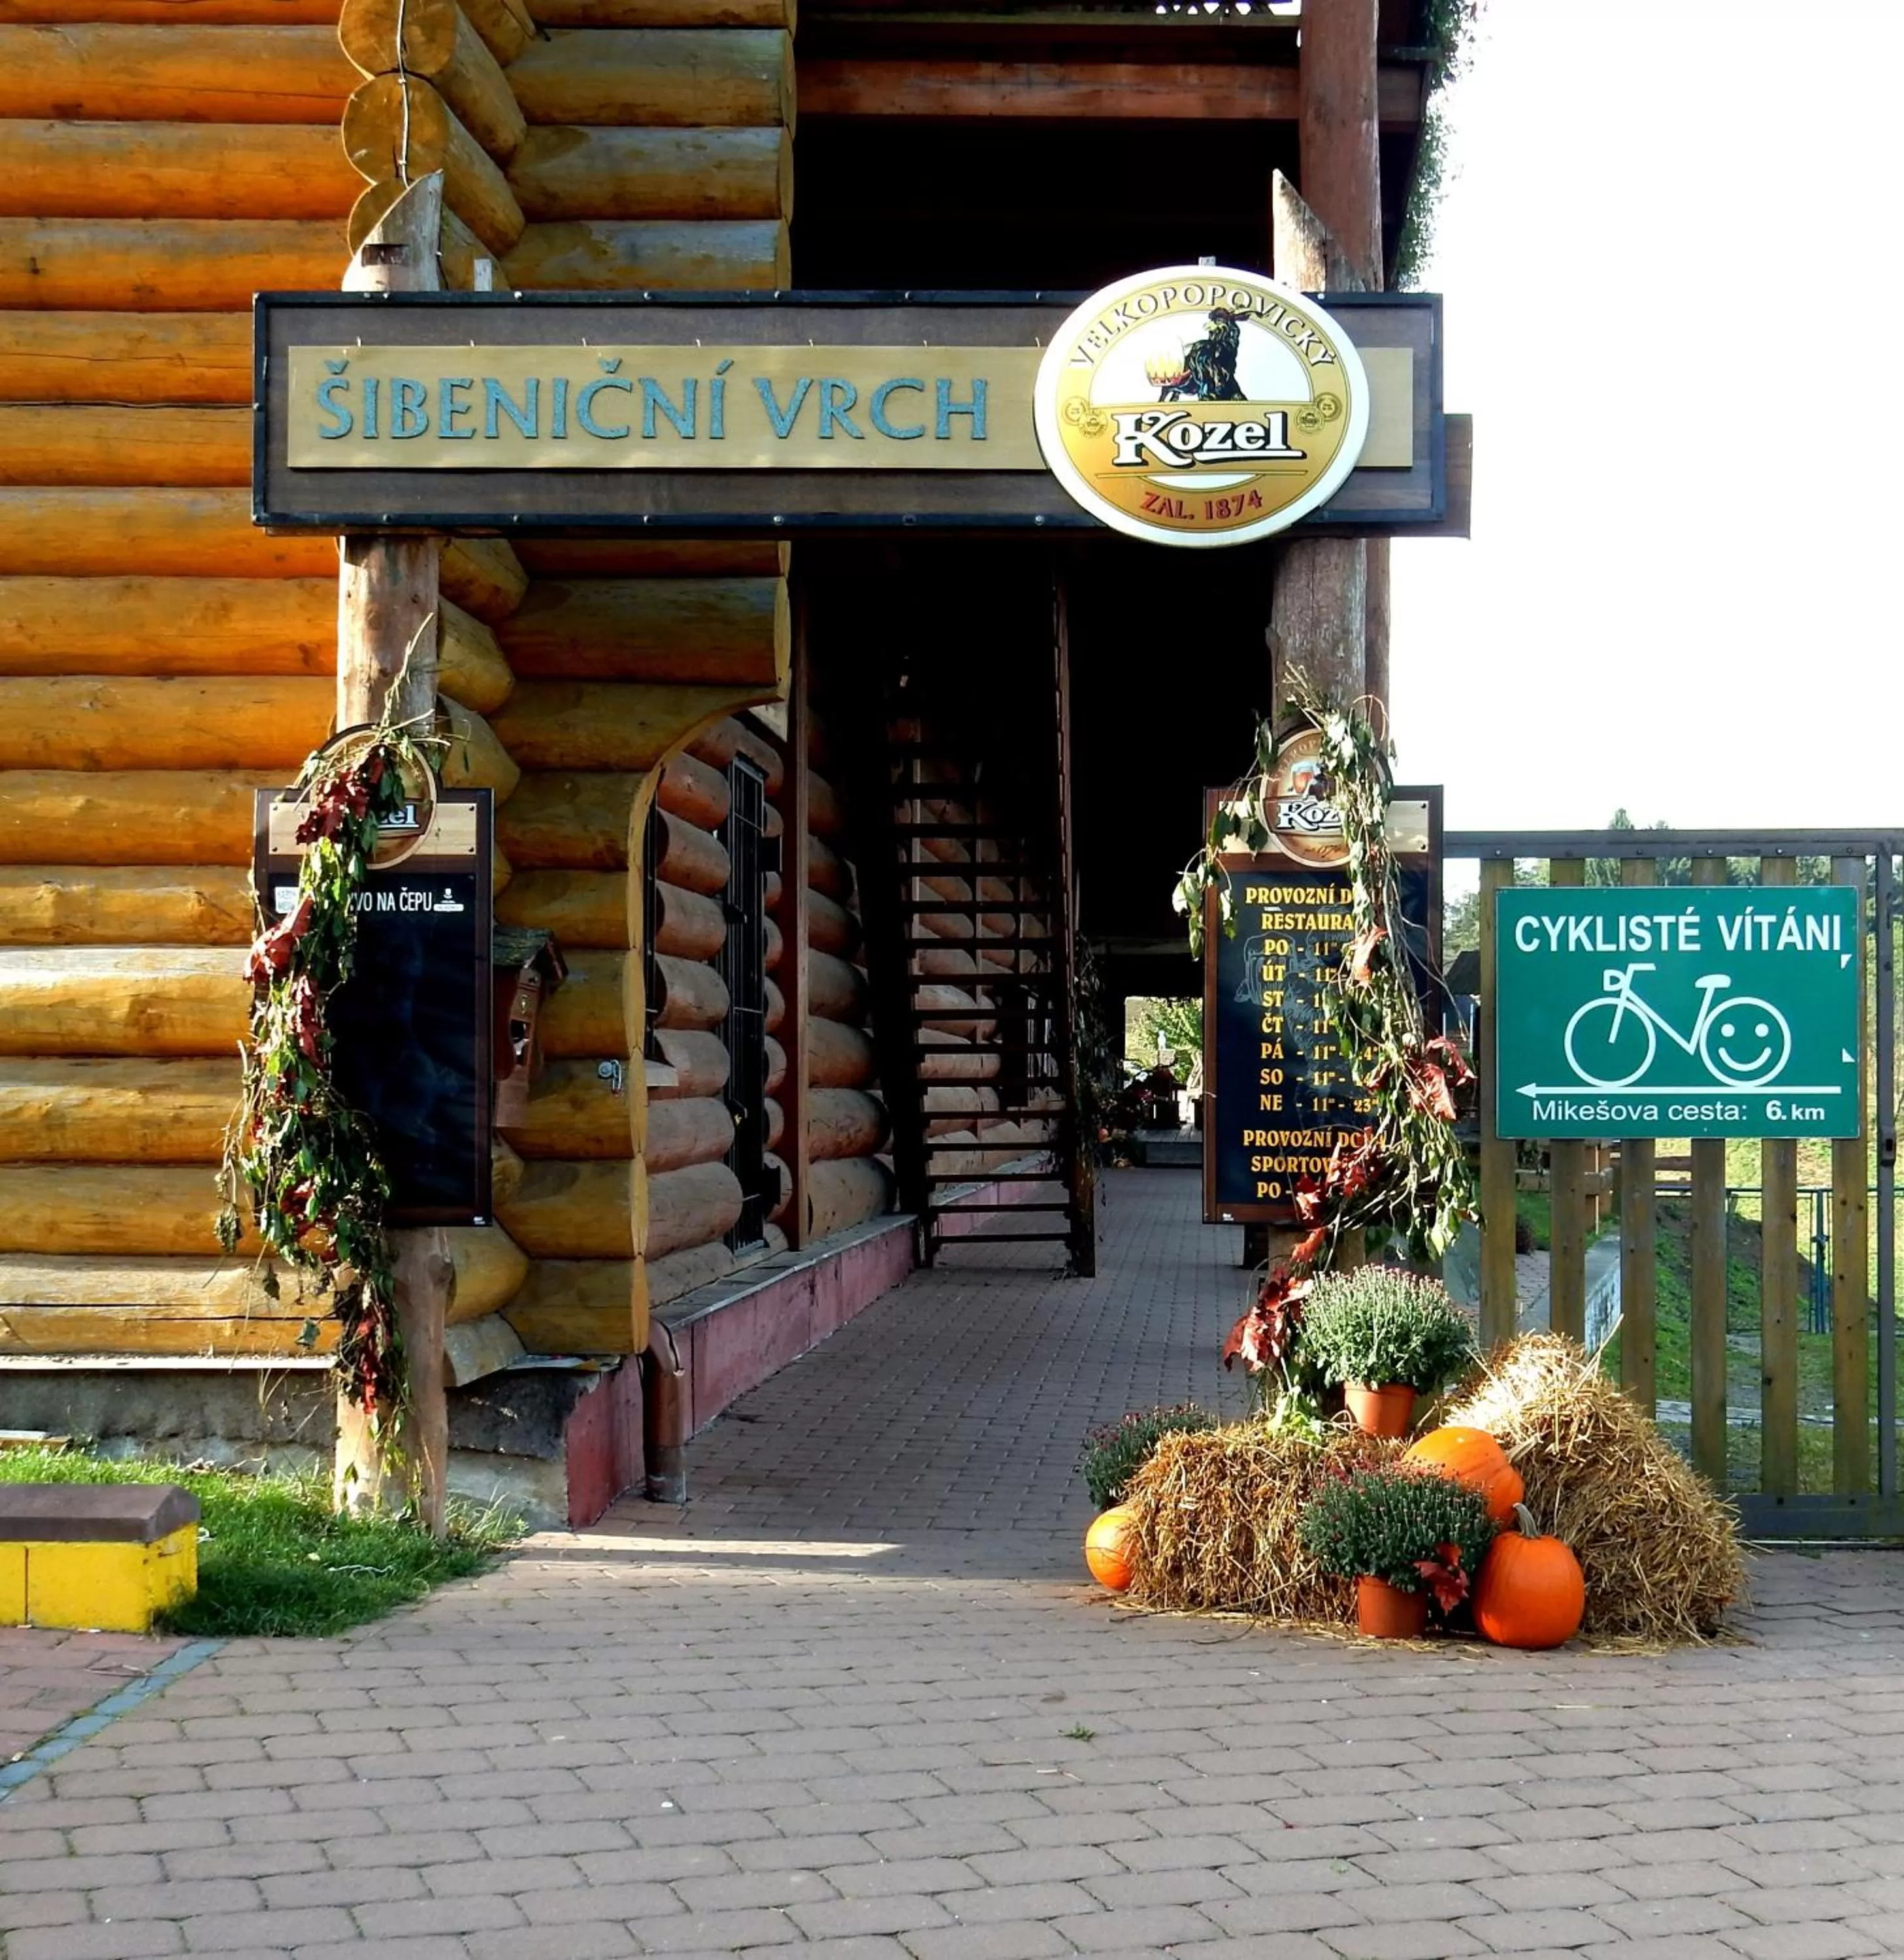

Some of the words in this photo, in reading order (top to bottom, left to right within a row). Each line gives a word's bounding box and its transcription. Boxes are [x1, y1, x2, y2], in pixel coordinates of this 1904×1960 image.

[316, 357, 734, 440] ŠIBENIČNÍ
[753, 378, 988, 440] VRCH
[1111, 410, 1297, 468] Kozel
[1140, 491, 1195, 520] ZAL.
[1205, 489, 1262, 520] 1874
[1277, 801, 1341, 831] Koz
[376, 892, 396, 911] NA
[399, 887, 432, 911] ČEPU
[1245, 883, 1335, 904] PROVOZNÍ
[1262, 914, 1354, 930] RESTAURA
[1515, 906, 1700, 952] CYKLISTÉ
[1717, 906, 1841, 952] VÍTÁNI
[1264, 939, 1288, 955] PO
[1262, 963, 1286, 981] ÚT
[1262, 991, 1283, 1007] ST
[1262, 1013, 1283, 1033] ČT
[1260, 1037, 1284, 1059] PÁ
[1260, 1069, 1283, 1085] SO
[1260, 1095, 1283, 1111] NE
[1533, 1100, 1658, 1121] Mikešova
[1668, 1103, 1747, 1121] cesta:
[1791, 1103, 1825, 1121] km
[1243, 1127, 1332, 1147] PROVOZNÍ
[1251, 1156, 1332, 1174] SPORTOV
[1256, 1182, 1281, 1198] PO
